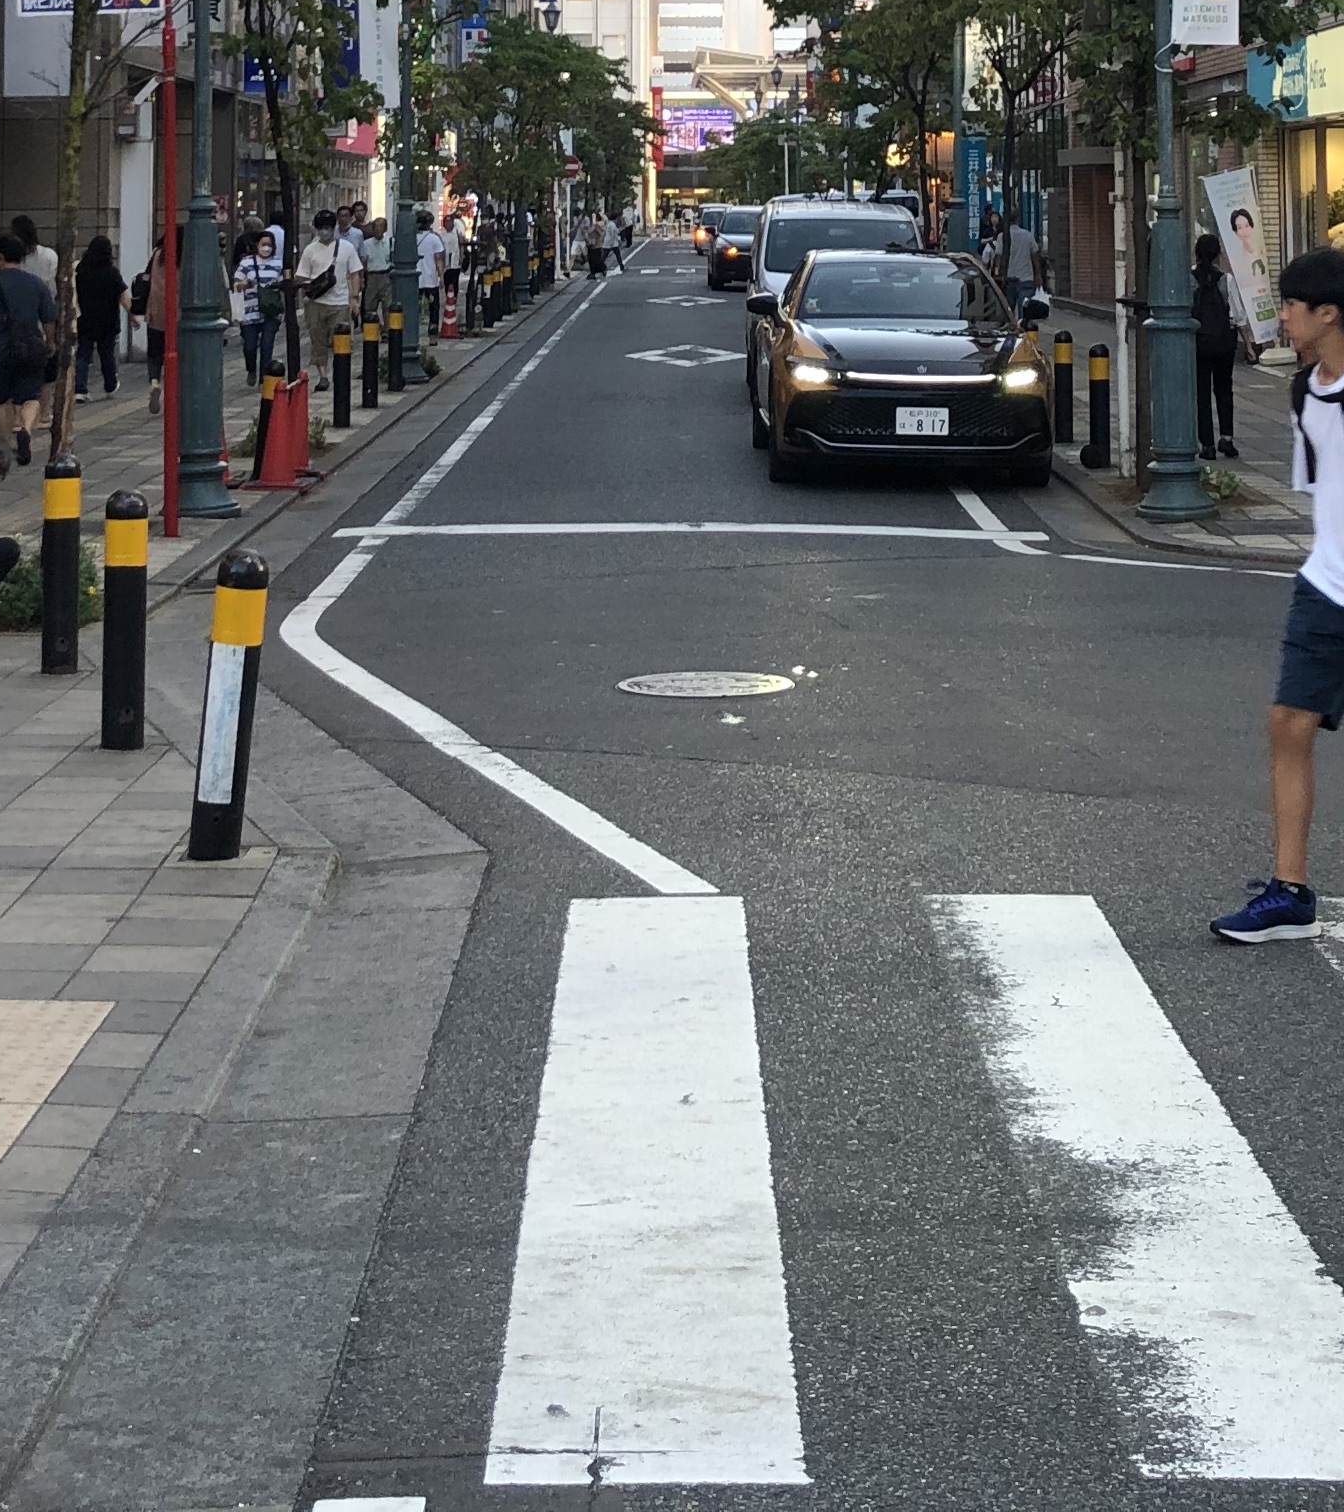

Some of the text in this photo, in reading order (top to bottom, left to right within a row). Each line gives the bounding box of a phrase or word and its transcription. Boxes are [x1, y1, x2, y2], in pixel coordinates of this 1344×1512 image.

[1183, 5, 1228, 13] KITEMITE
[1182, 15, 1228, 23] MATSUDO
[968, 149, 980, 240] 三井住友信託銀行
